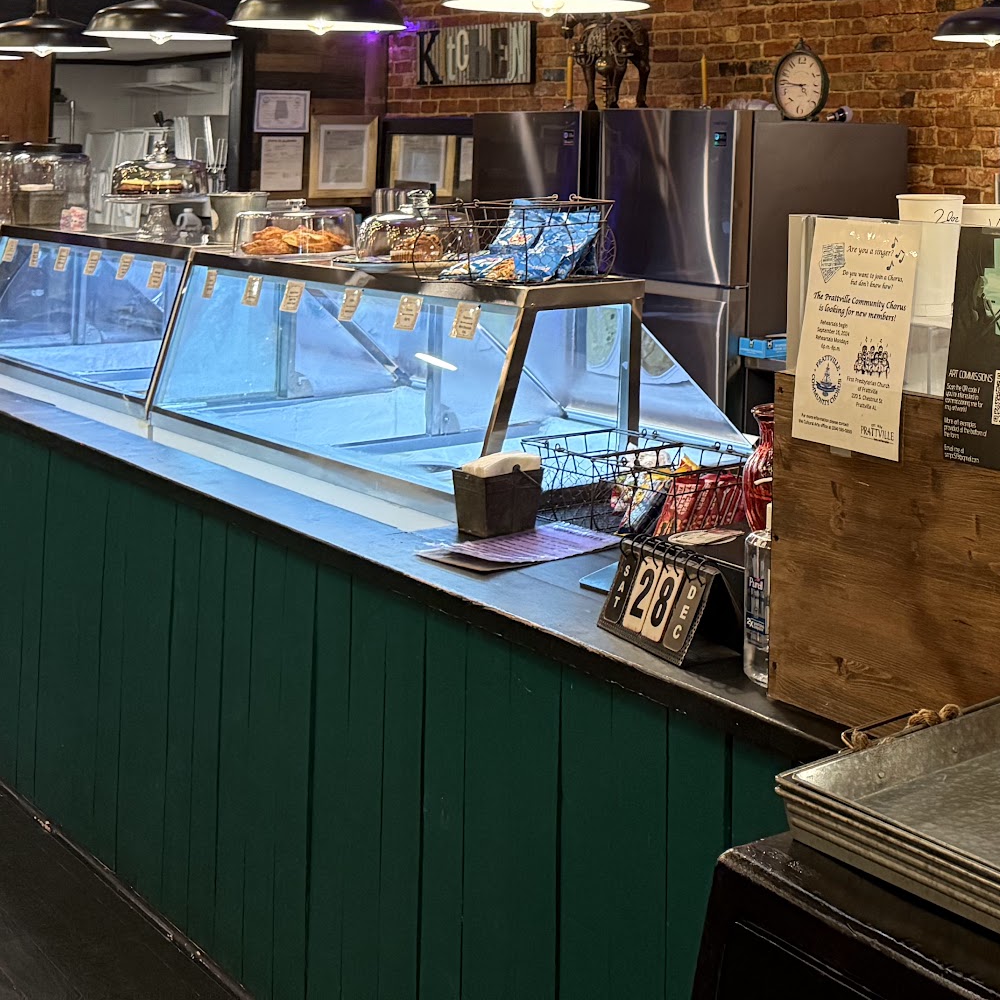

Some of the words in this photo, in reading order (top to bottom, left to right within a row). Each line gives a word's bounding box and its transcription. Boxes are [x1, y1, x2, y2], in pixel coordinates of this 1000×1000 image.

[814, 291, 823, 300] The
[825, 294, 851, 304] Prattville
[852, 297, 885, 311] Community
[886, 301, 906, 311] Chorus
[825, 304, 845, 317] looking
[845, 306, 854, 318] for
[868, 312, 896, 321] members!
[861, 425, 894, 441] PRATTVILLE
[613, 565, 630, 608] SAT
[630, 568, 675, 628] 28
[673, 585, 697, 639] DEC
